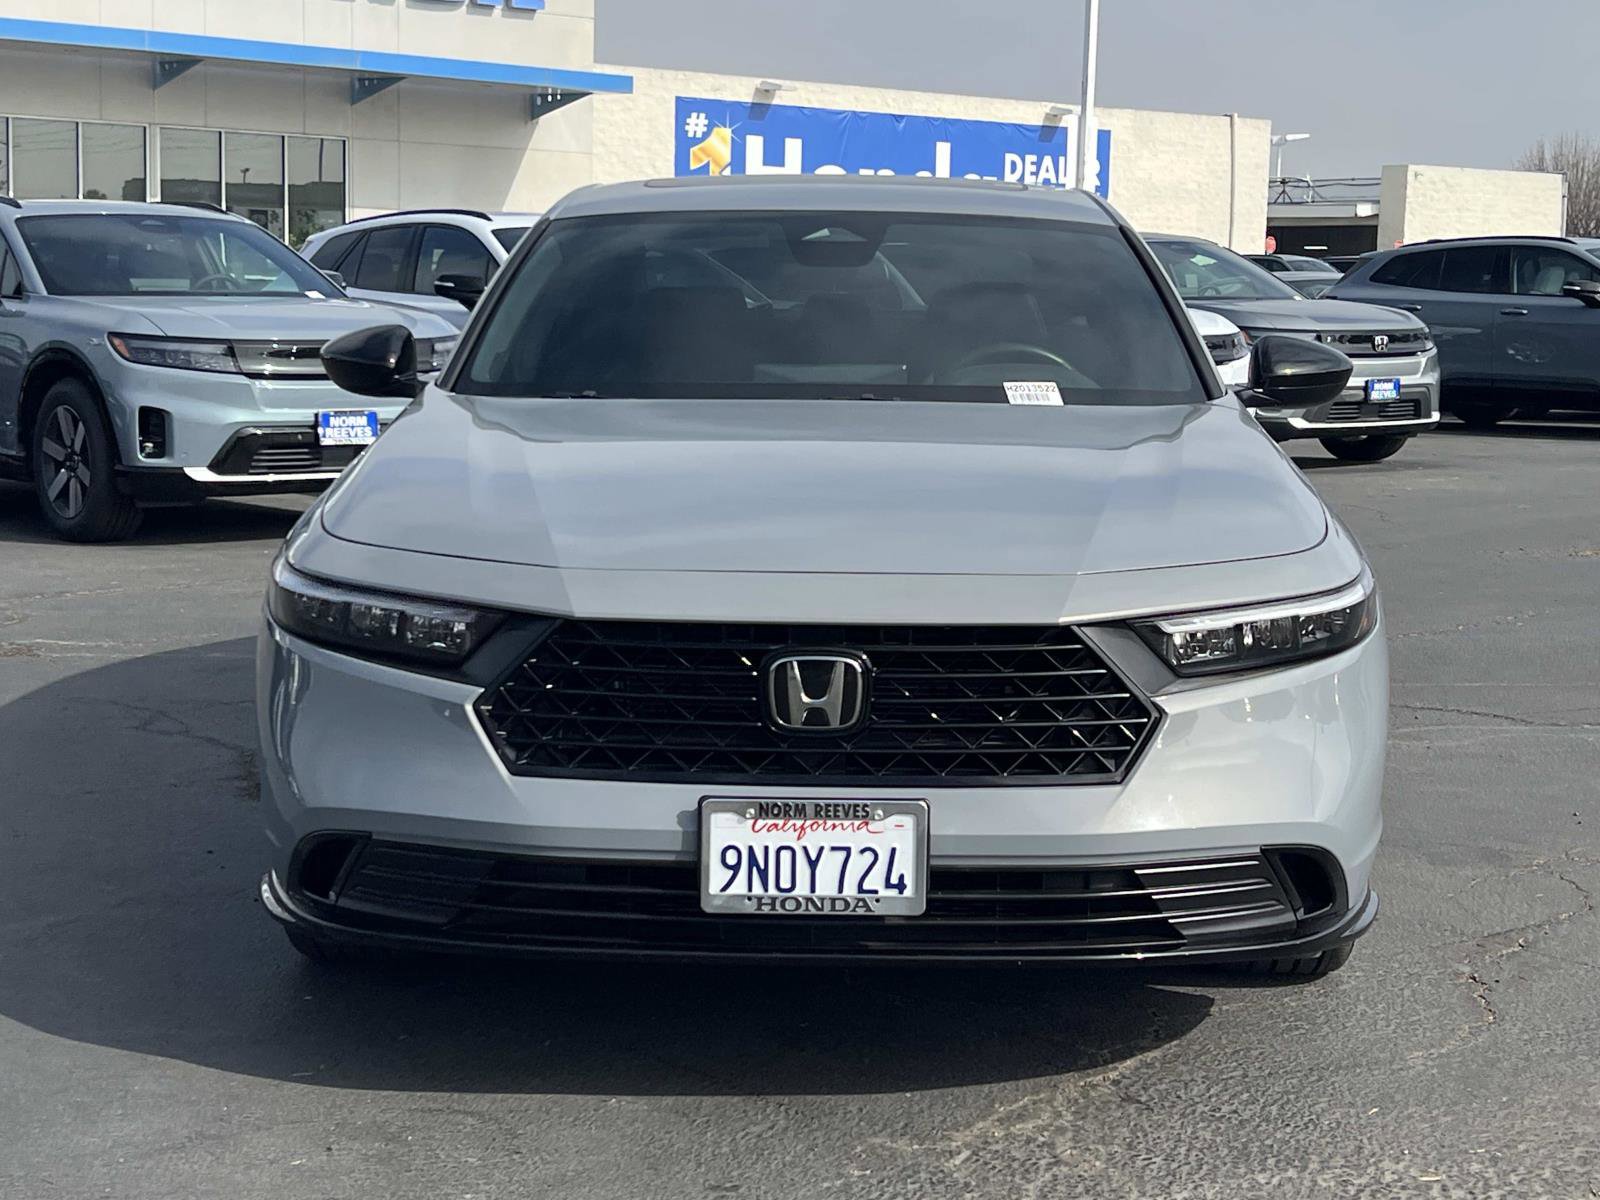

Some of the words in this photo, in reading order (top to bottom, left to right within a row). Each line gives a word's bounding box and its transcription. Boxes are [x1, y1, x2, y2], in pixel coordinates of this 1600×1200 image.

[329, 415, 368, 427] NORM
[325, 426, 372, 438] REEVES
[759, 801, 806, 818] NORM
[814, 802, 870, 819] REEVES
[751, 817, 884, 841] California
[719, 844, 907, 895] 9NOY724
[754, 896, 875, 913] HONDA
